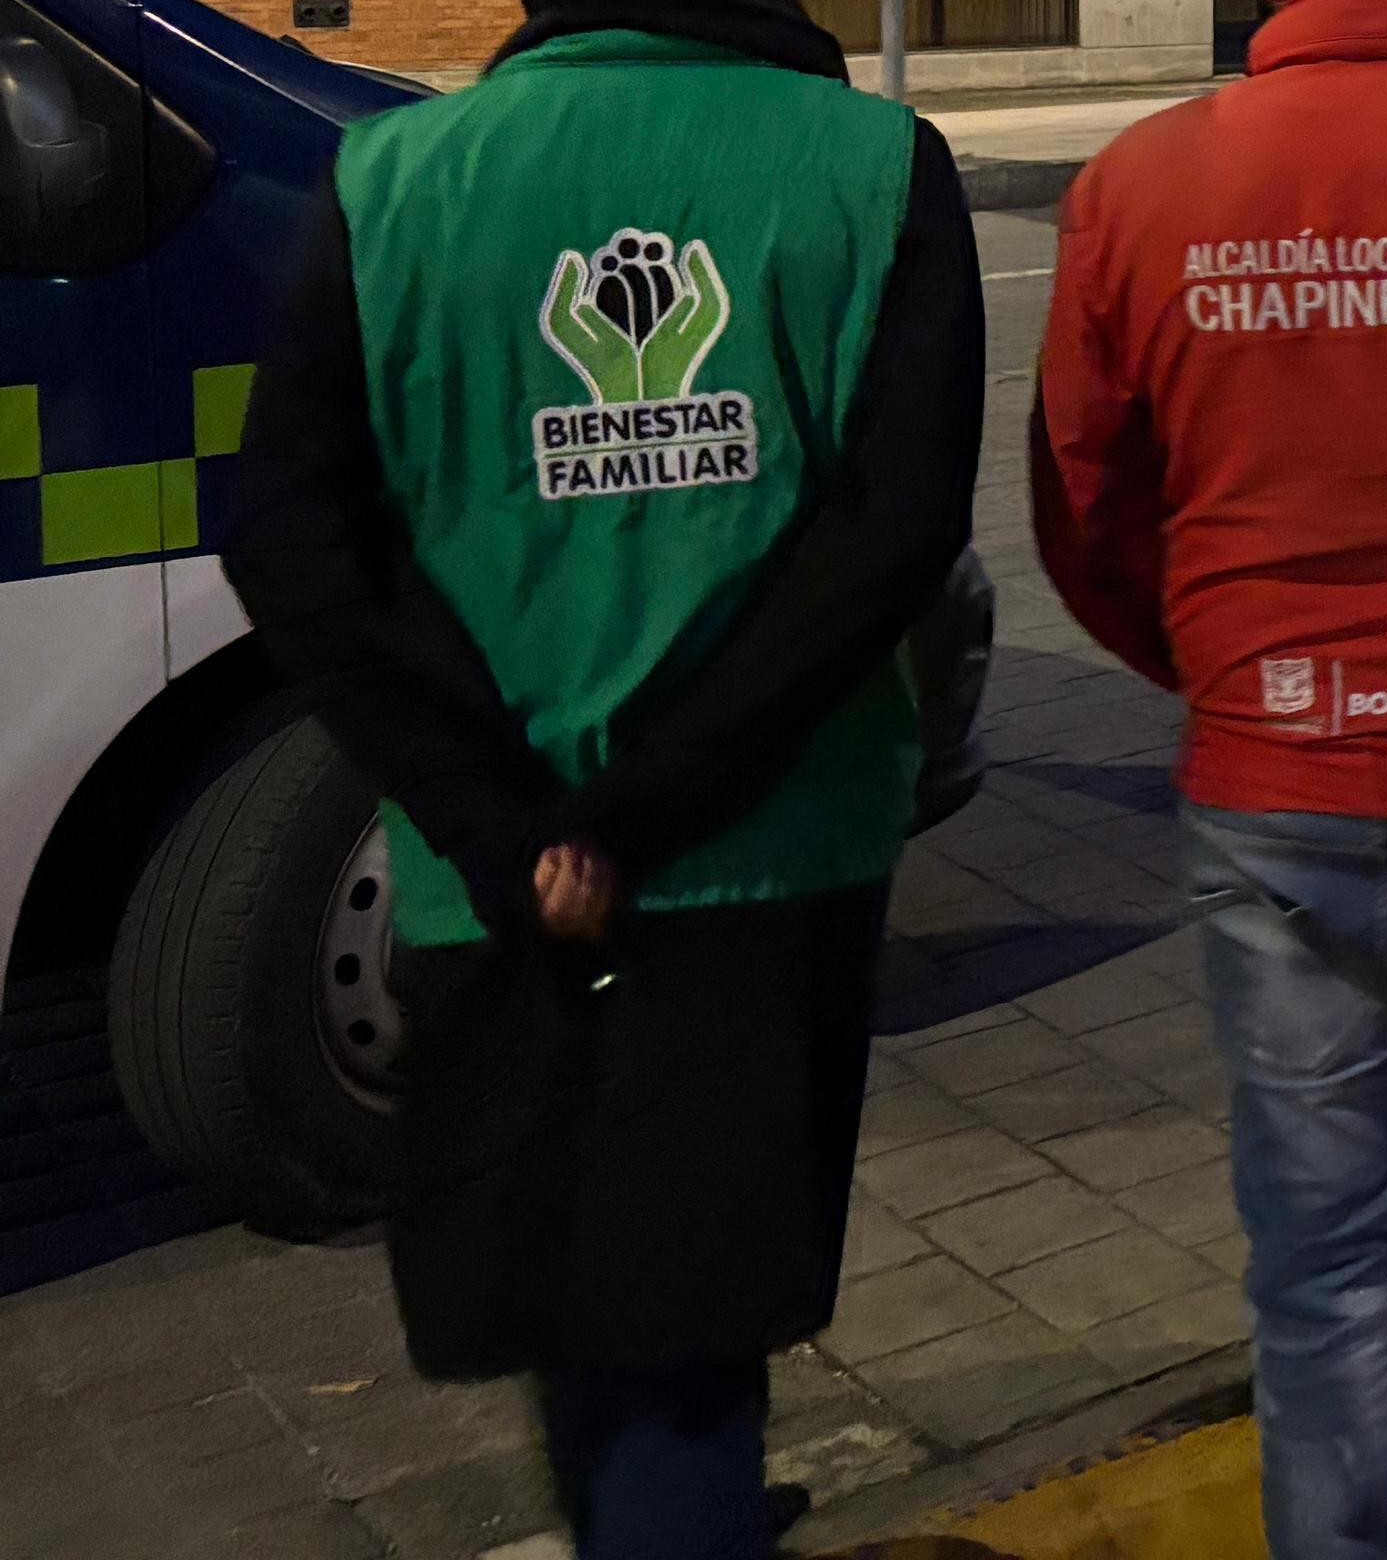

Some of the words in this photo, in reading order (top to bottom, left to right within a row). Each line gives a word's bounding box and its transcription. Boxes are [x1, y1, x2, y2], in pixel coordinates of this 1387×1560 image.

[1184, 228, 1333, 279] ALCALDÍA
[542, 399, 745, 450] BIENESTAR
[547, 443, 749, 494] FAMILIAR
